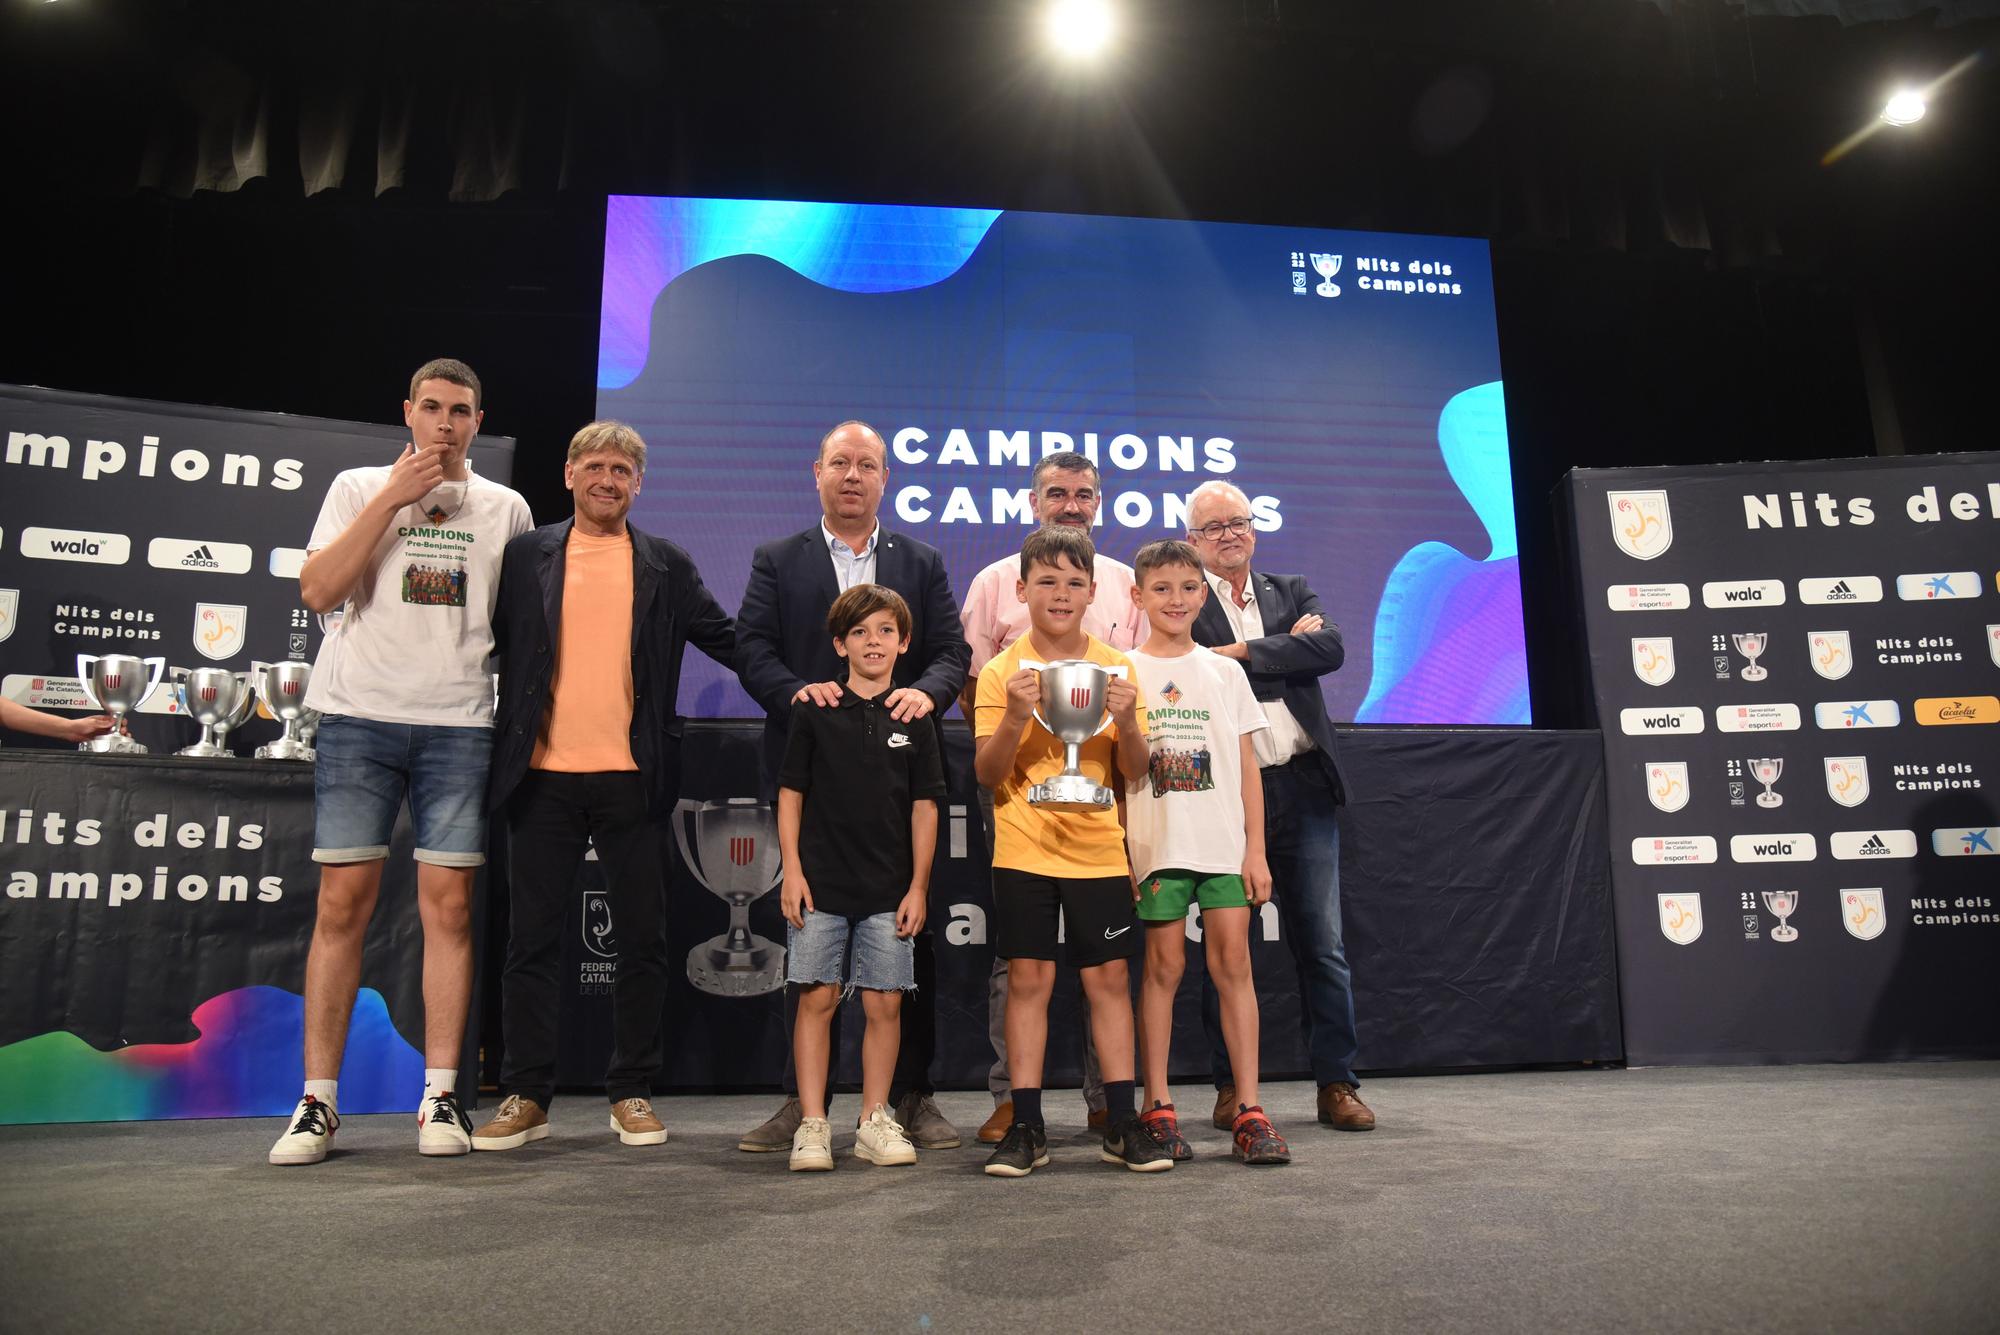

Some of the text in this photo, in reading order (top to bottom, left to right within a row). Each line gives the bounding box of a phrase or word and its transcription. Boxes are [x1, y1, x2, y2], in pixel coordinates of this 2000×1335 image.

[1356, 257, 1453, 276] Nits dels
[1357, 276, 1462, 295] Campions
[892, 426, 1237, 474] CAMPIONS
[1743, 492, 1876, 530] Nits
[397, 526, 475, 543] CAMPIONS
[50, 538, 99, 556] wala
[406, 540, 467, 551] Pre-Benjamins
[181, 557, 219, 568] adidas
[1725, 586, 1762, 602] wala
[1826, 591, 1857, 600] adidas
[55, 604, 155, 623] Nits dels
[291, 608, 308, 618] 21
[291, 618, 308, 628] 22
[54, 622, 161, 640] Campions
[1712, 635, 1725, 643] 21
[1876, 636, 1954, 650] Nits dels
[1712, 643, 1727, 651] 22
[1878, 651, 1963, 665] Campions
[1147, 708, 1211, 721] AMPIONS
[1643, 714, 1681, 729] wala
[891, 732, 909, 743] NIKE
[1727, 760, 1741, 768] 21
[1893, 763, 1973, 776] Nits dels
[1728, 768, 1742, 777] 22
[1895, 778, 1982, 792] Campions
[134, 813, 264, 850] dels
[1753, 840, 1792, 856] wala
[1858, 846, 1891, 856] adidas
[1741, 892, 1755, 901] 21
[1911, 897, 1992, 909] Nits dels
[1742, 901, 1757, 910] 22
[1913, 912, 2000, 926] Campions
